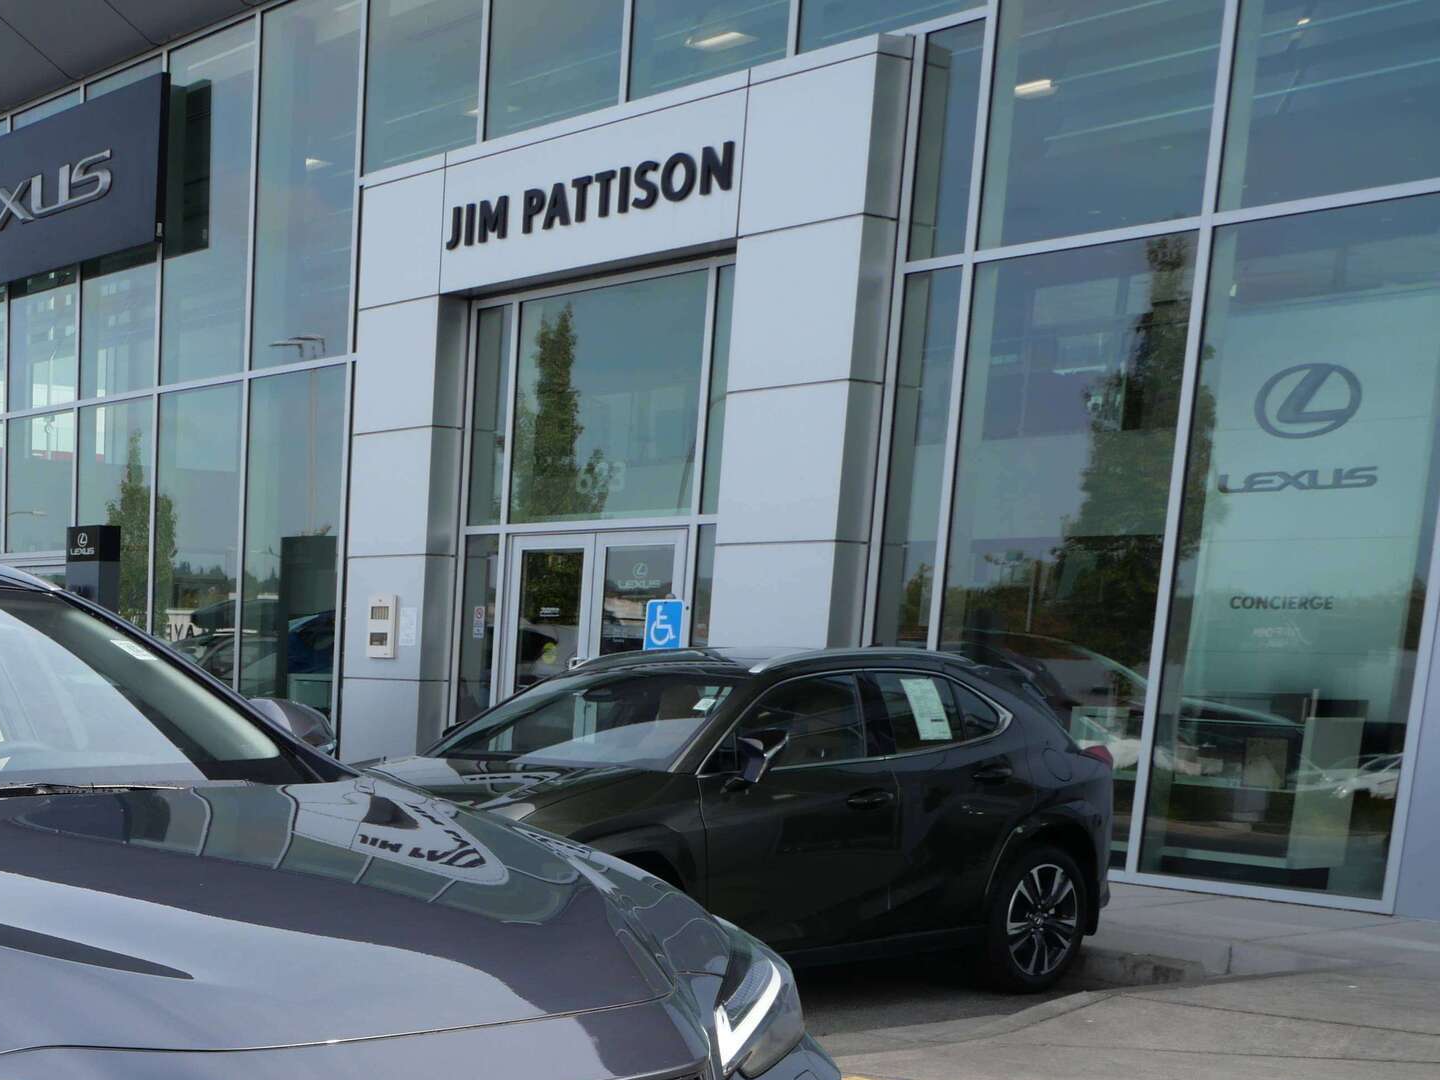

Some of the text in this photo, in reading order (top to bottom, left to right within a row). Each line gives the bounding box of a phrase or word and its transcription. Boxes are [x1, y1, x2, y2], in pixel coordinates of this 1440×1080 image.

[445, 140, 736, 251] JIM PATTISON
[1217, 465, 1379, 494] LEXUS
[70, 547, 95, 556] LEXUS
[617, 579, 661, 589] LEXUS
[1230, 596, 1334, 610] CONCIERGE
